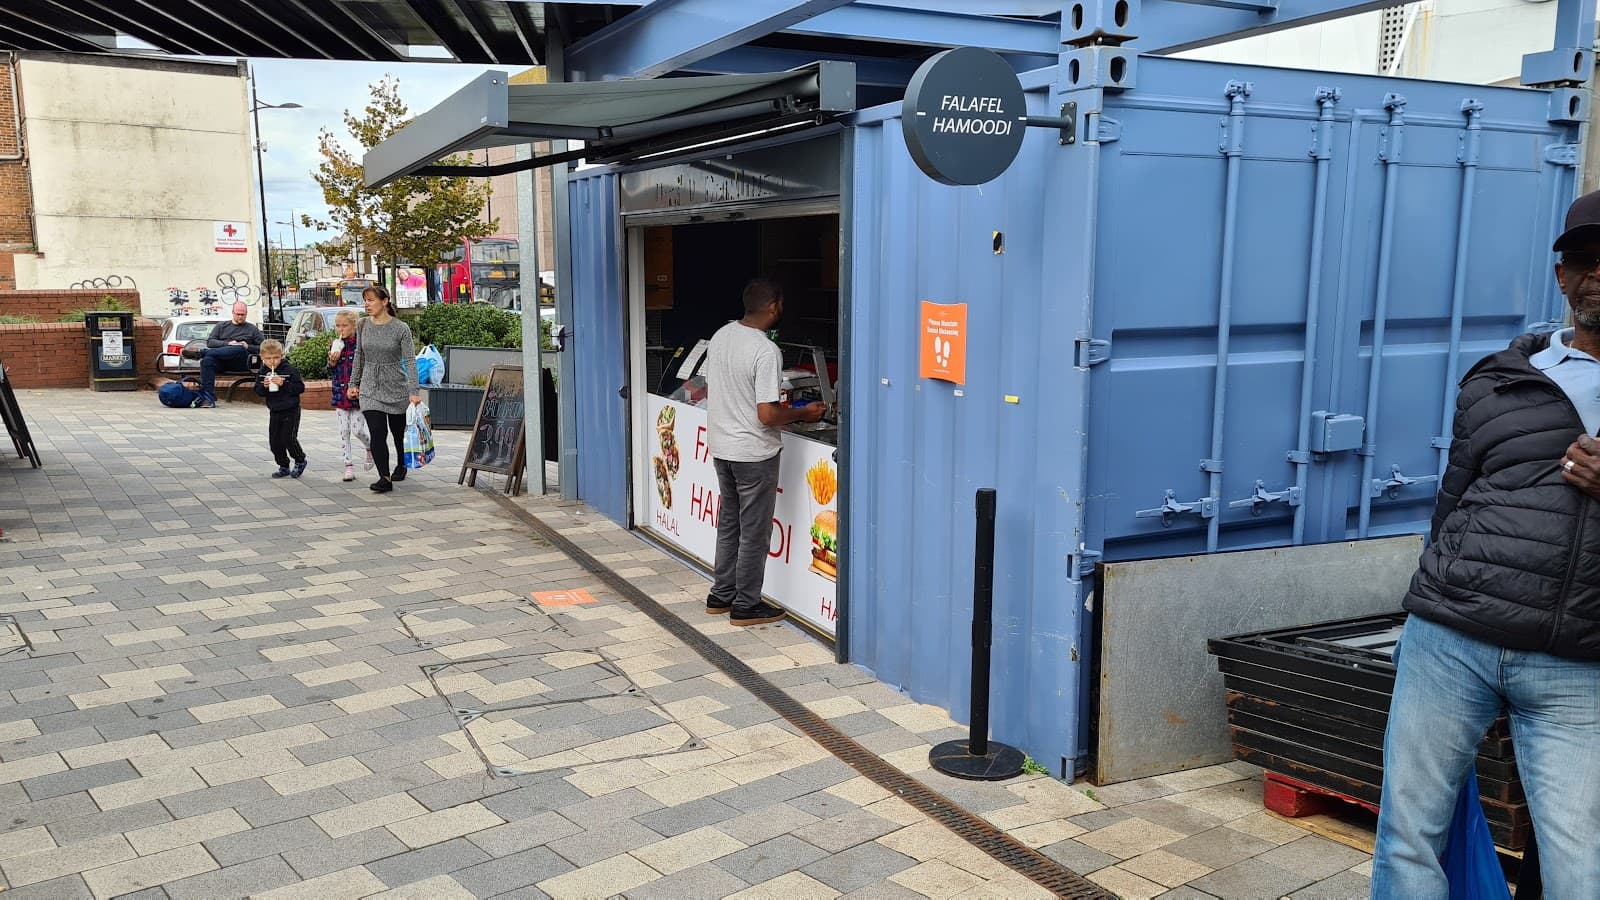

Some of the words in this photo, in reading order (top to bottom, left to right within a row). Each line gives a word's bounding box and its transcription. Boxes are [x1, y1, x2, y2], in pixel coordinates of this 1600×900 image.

[941, 95, 1004, 113] FALAFEL
[932, 117, 1012, 135] HAMOODI
[656, 509, 680, 537] HALAL
